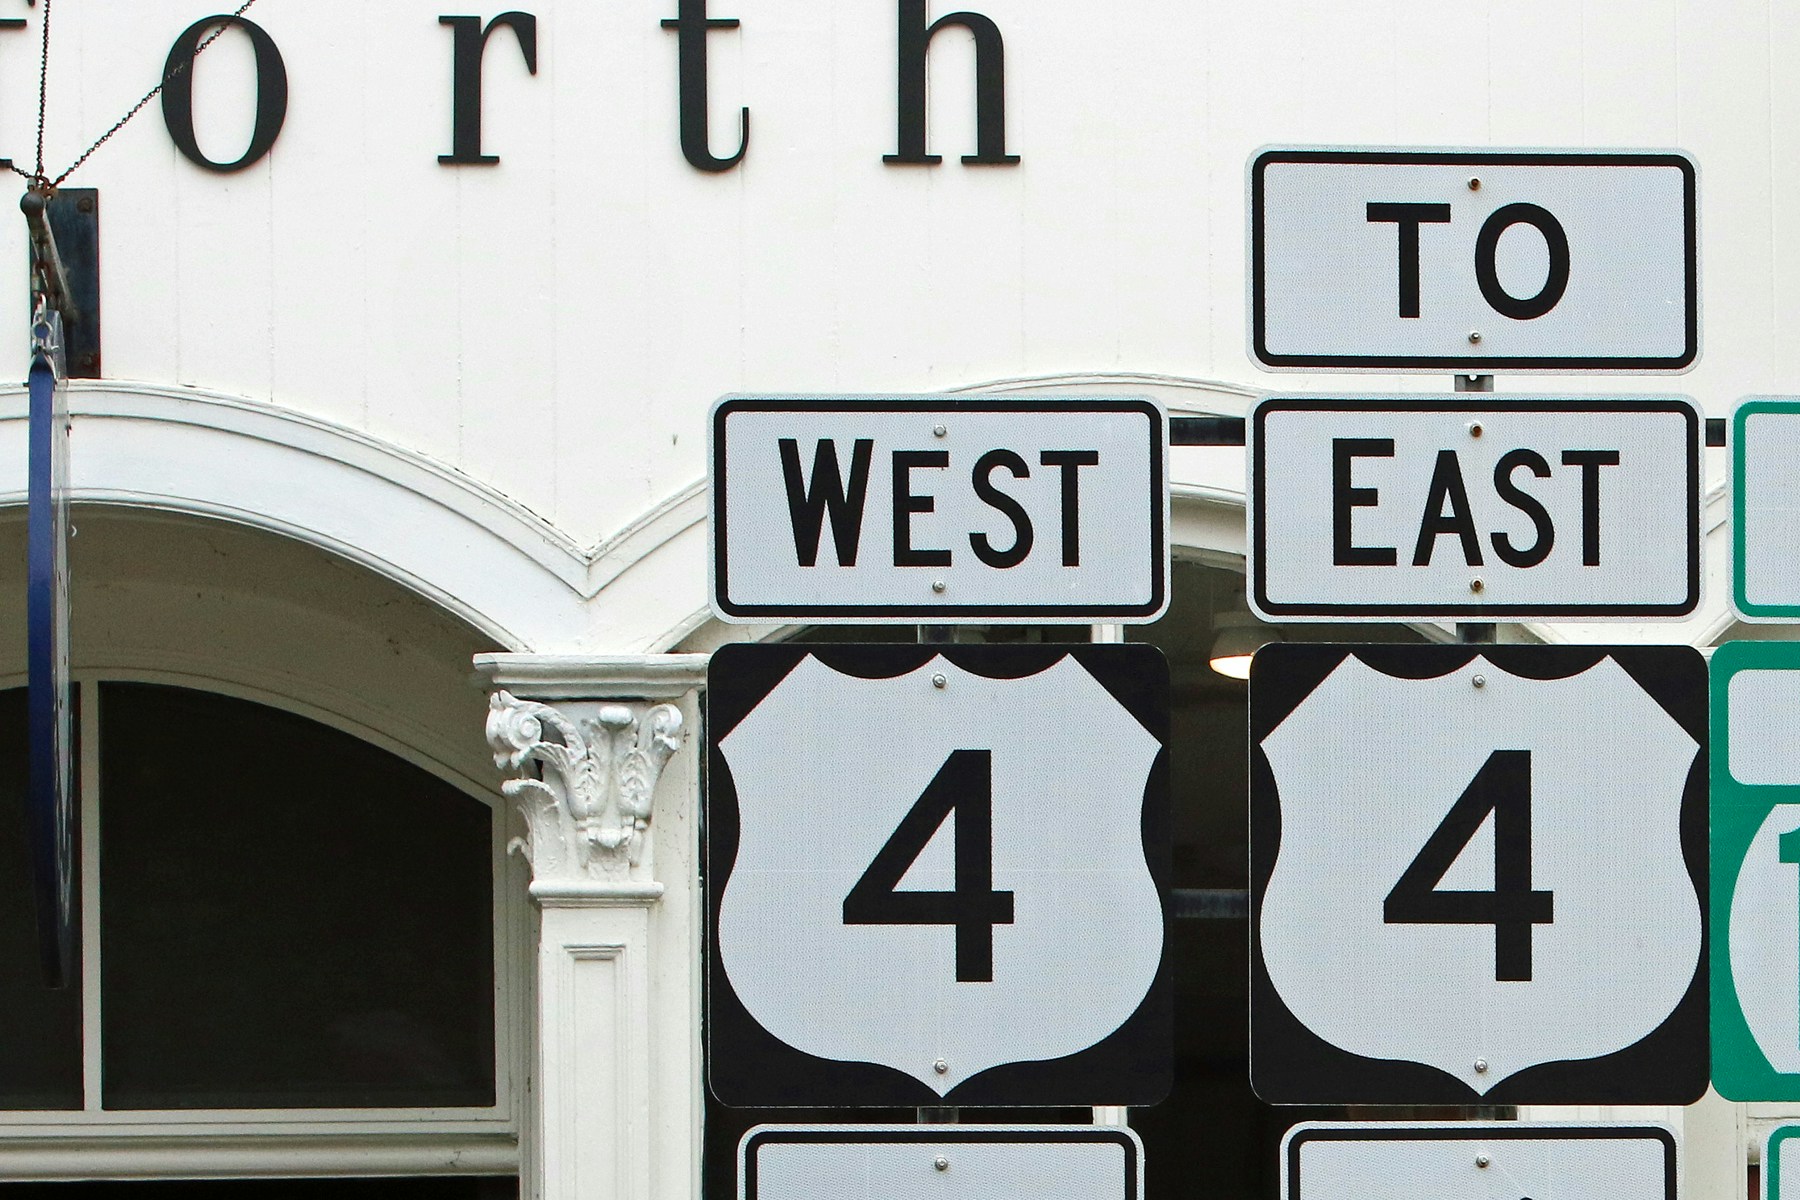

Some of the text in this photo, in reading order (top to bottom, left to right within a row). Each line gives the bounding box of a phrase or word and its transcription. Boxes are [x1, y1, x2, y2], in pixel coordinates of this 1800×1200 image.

[0, 0, 1021, 174] orth
[1366, 201, 1571, 321] TO
[777, 437, 1099, 570] WEST
[1332, 437, 1621, 569] EAST
[843, 748, 1015, 983] 4
[1382, 749, 1554, 983] 4
